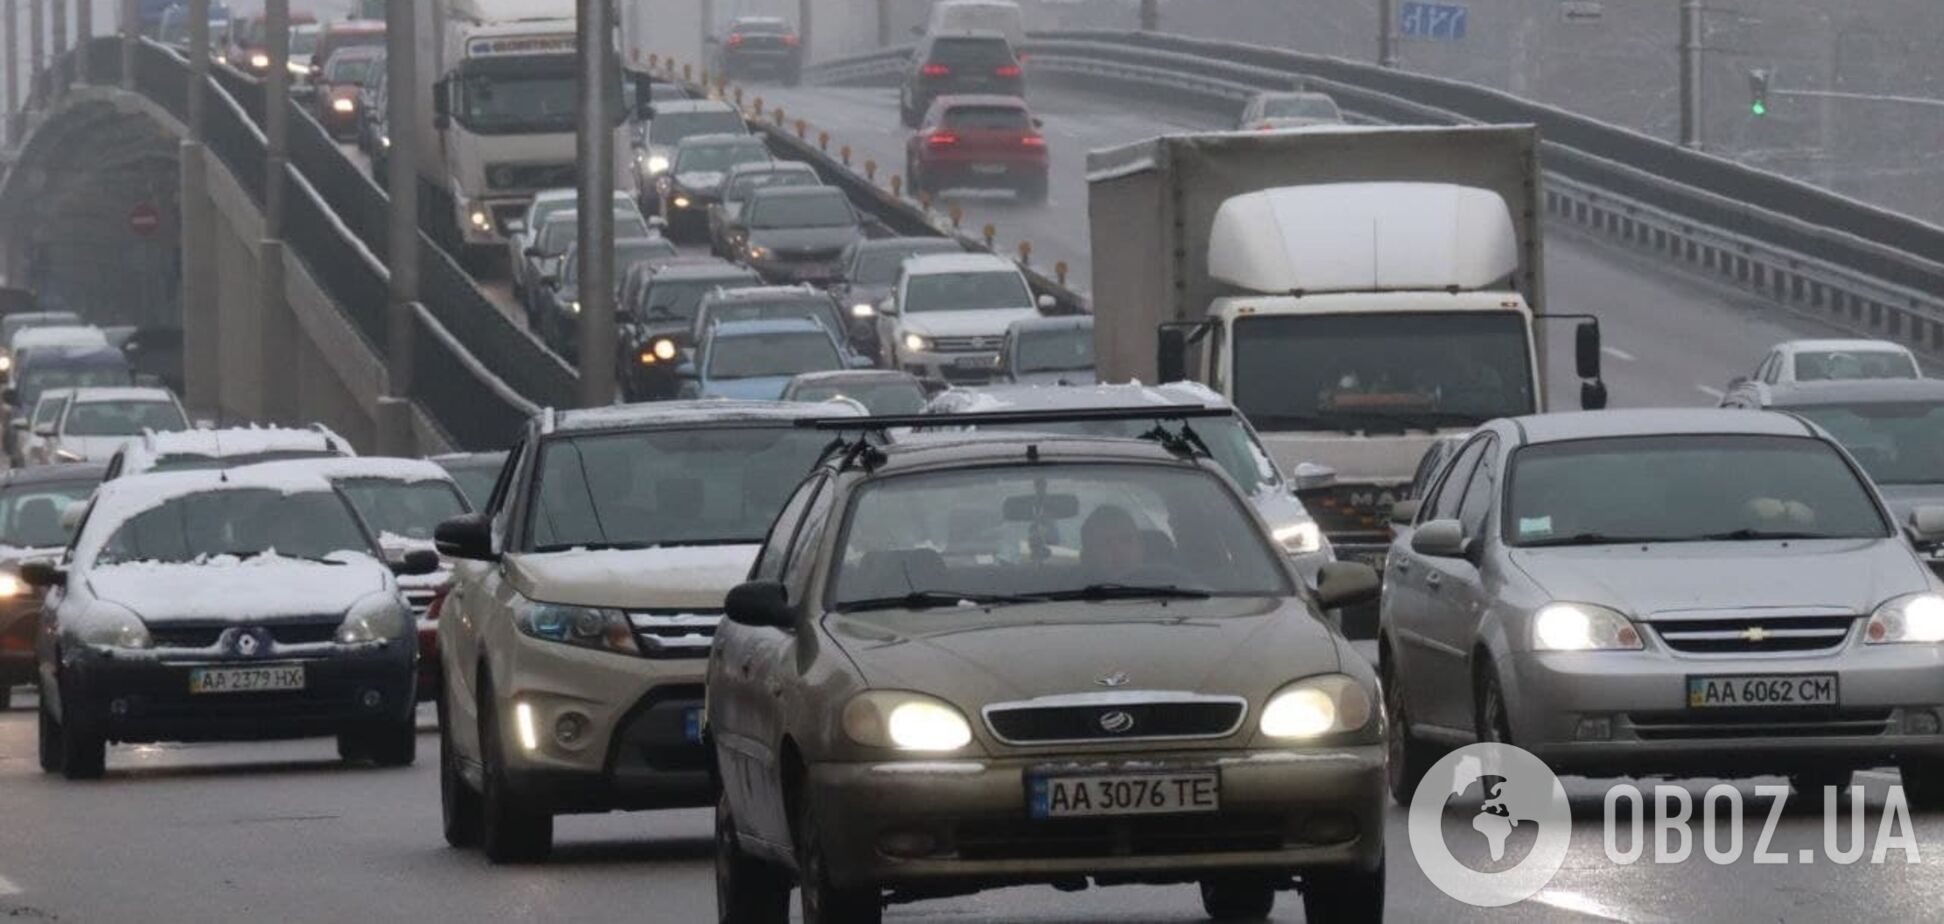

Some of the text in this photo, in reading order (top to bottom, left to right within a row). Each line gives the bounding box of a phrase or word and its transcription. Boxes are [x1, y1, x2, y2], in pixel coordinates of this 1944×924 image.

[203, 672, 225, 688] AA
[232, 670, 271, 688] 2379
[1706, 679, 1831, 702] AA 6062 CM
[1051, 782, 1091, 810] AA
[1099, 781, 1165, 808] 3076
[1172, 778, 1213, 806] TE
